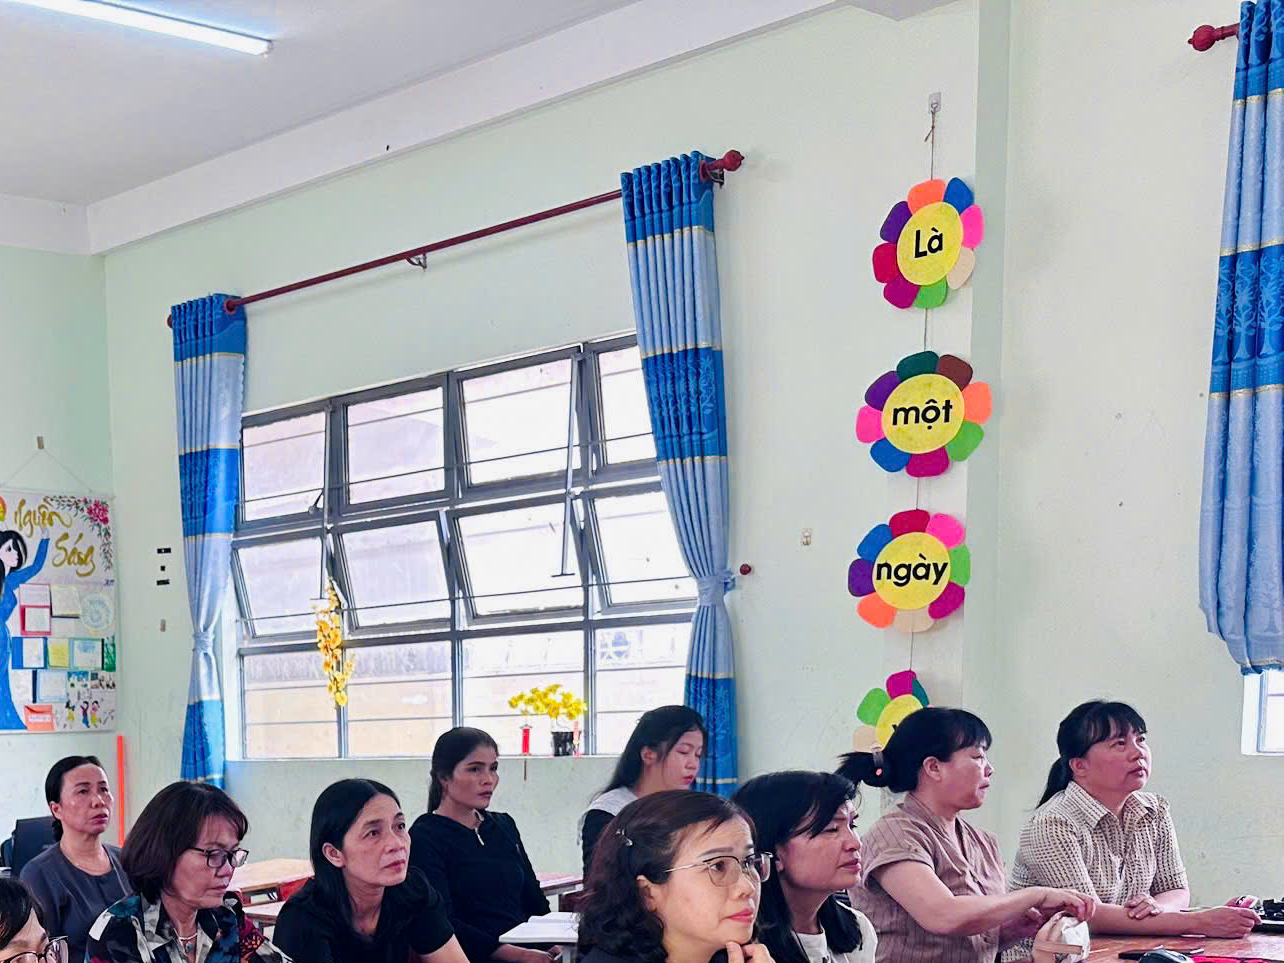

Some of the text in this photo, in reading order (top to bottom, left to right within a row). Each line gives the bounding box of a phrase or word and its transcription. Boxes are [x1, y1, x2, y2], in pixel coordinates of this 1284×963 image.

[914, 226, 944, 259] Là
[892, 398, 953, 430] một
[875, 552, 949, 587] ngày
